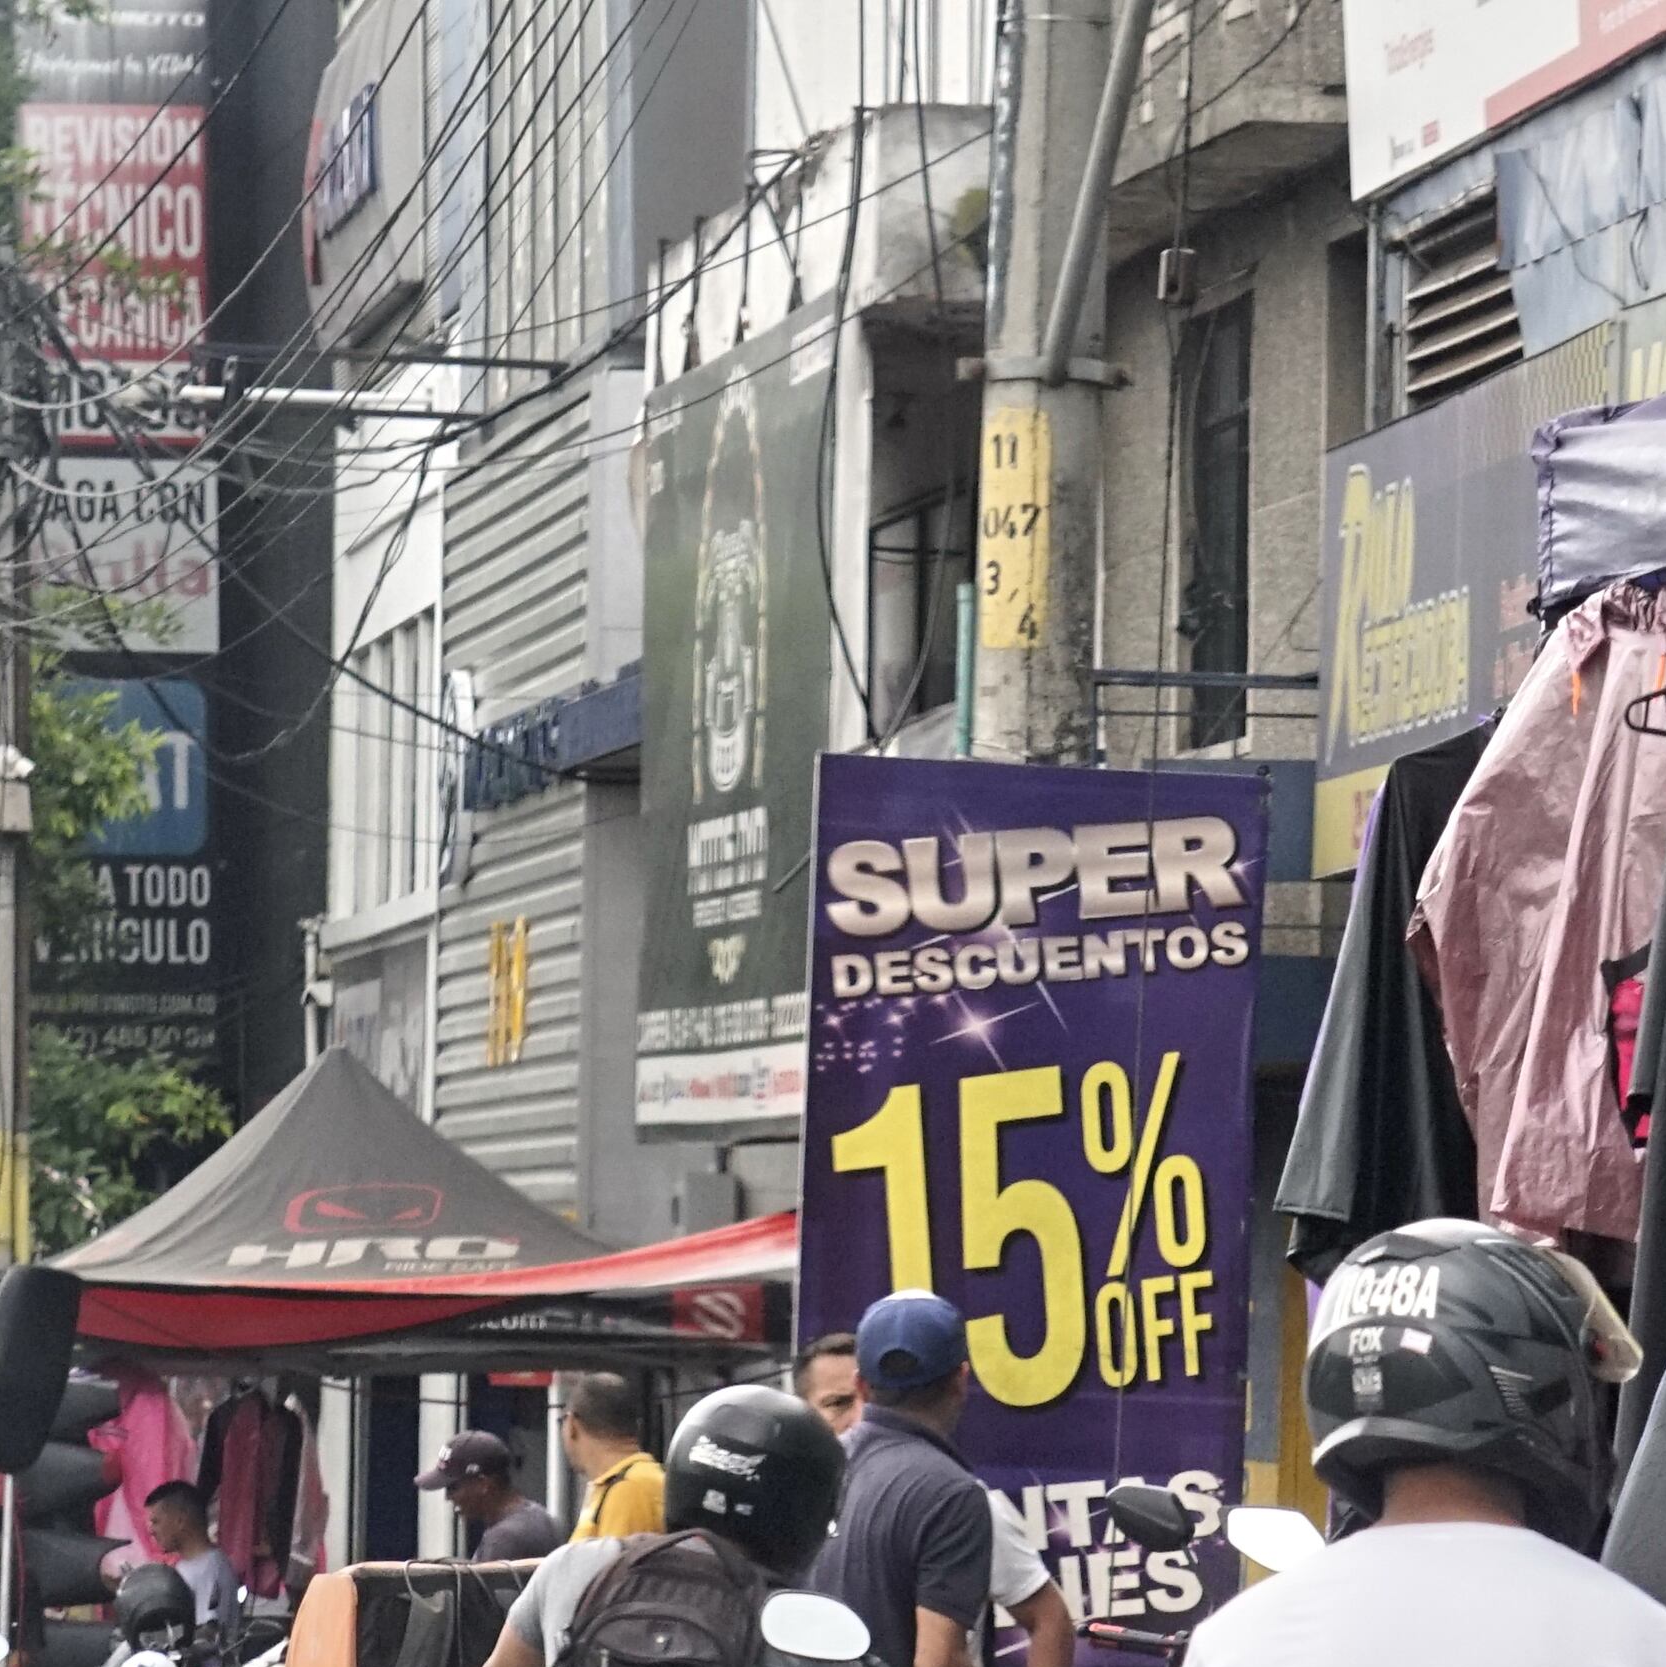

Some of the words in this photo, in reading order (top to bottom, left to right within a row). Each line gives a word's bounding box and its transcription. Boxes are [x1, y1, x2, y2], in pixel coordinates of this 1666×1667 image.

[124, 864, 211, 908] TODO
[826, 816, 1245, 938] SUPER
[831, 922, 1250, 998] DESCUENTOS
[832, 1051, 1207, 1408] 15%
[1095, 1270, 1214, 1389] OFF
[1347, 1326, 1384, 1357] FOX
